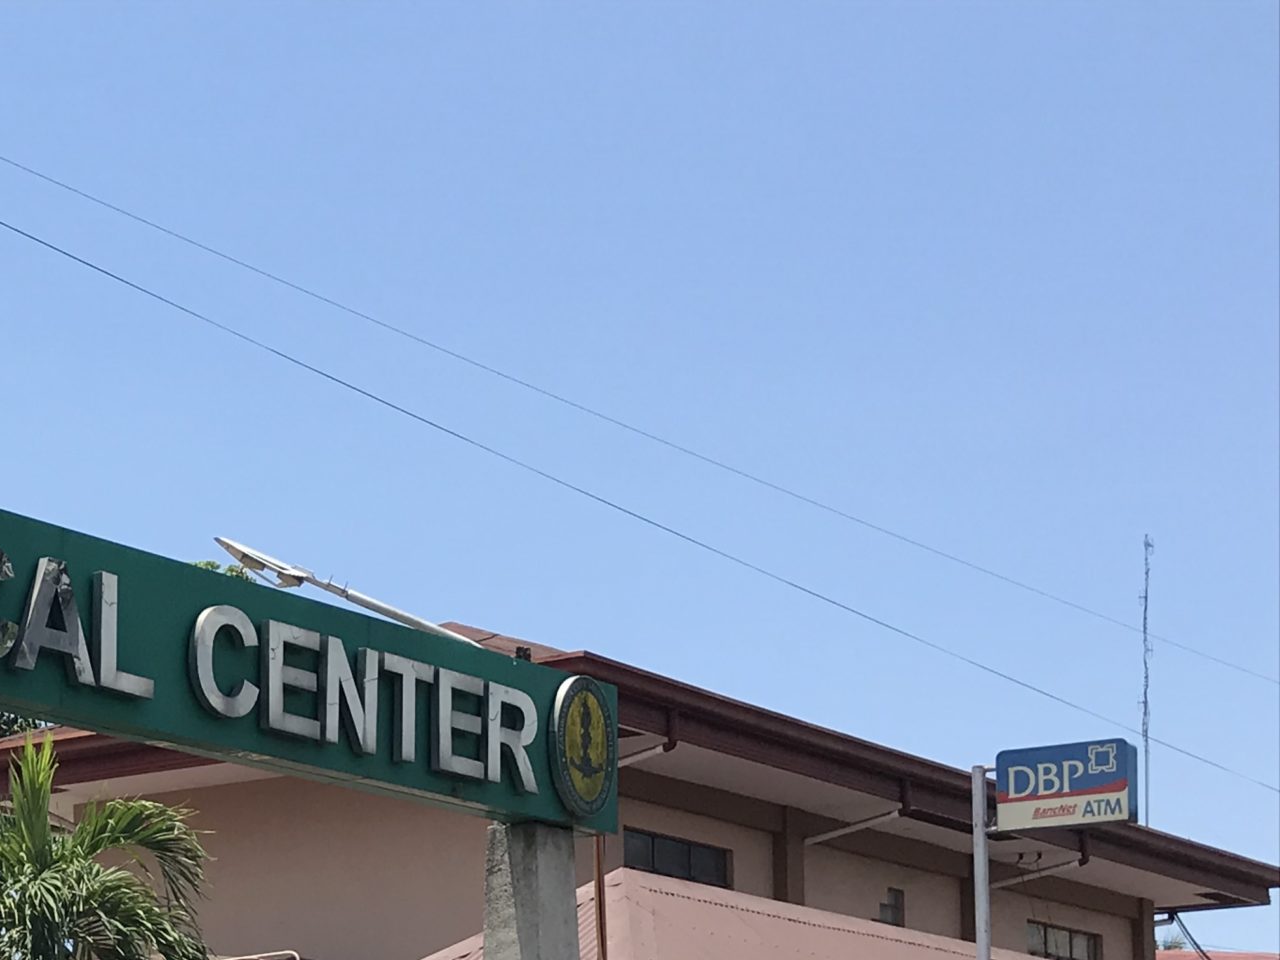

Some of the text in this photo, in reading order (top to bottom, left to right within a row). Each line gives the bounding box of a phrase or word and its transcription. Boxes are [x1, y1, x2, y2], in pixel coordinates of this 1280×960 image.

[189, 604, 540, 795] CENTER
[1007, 760, 1084, 799] DBP
[1082, 798, 1123, 818] ATM
